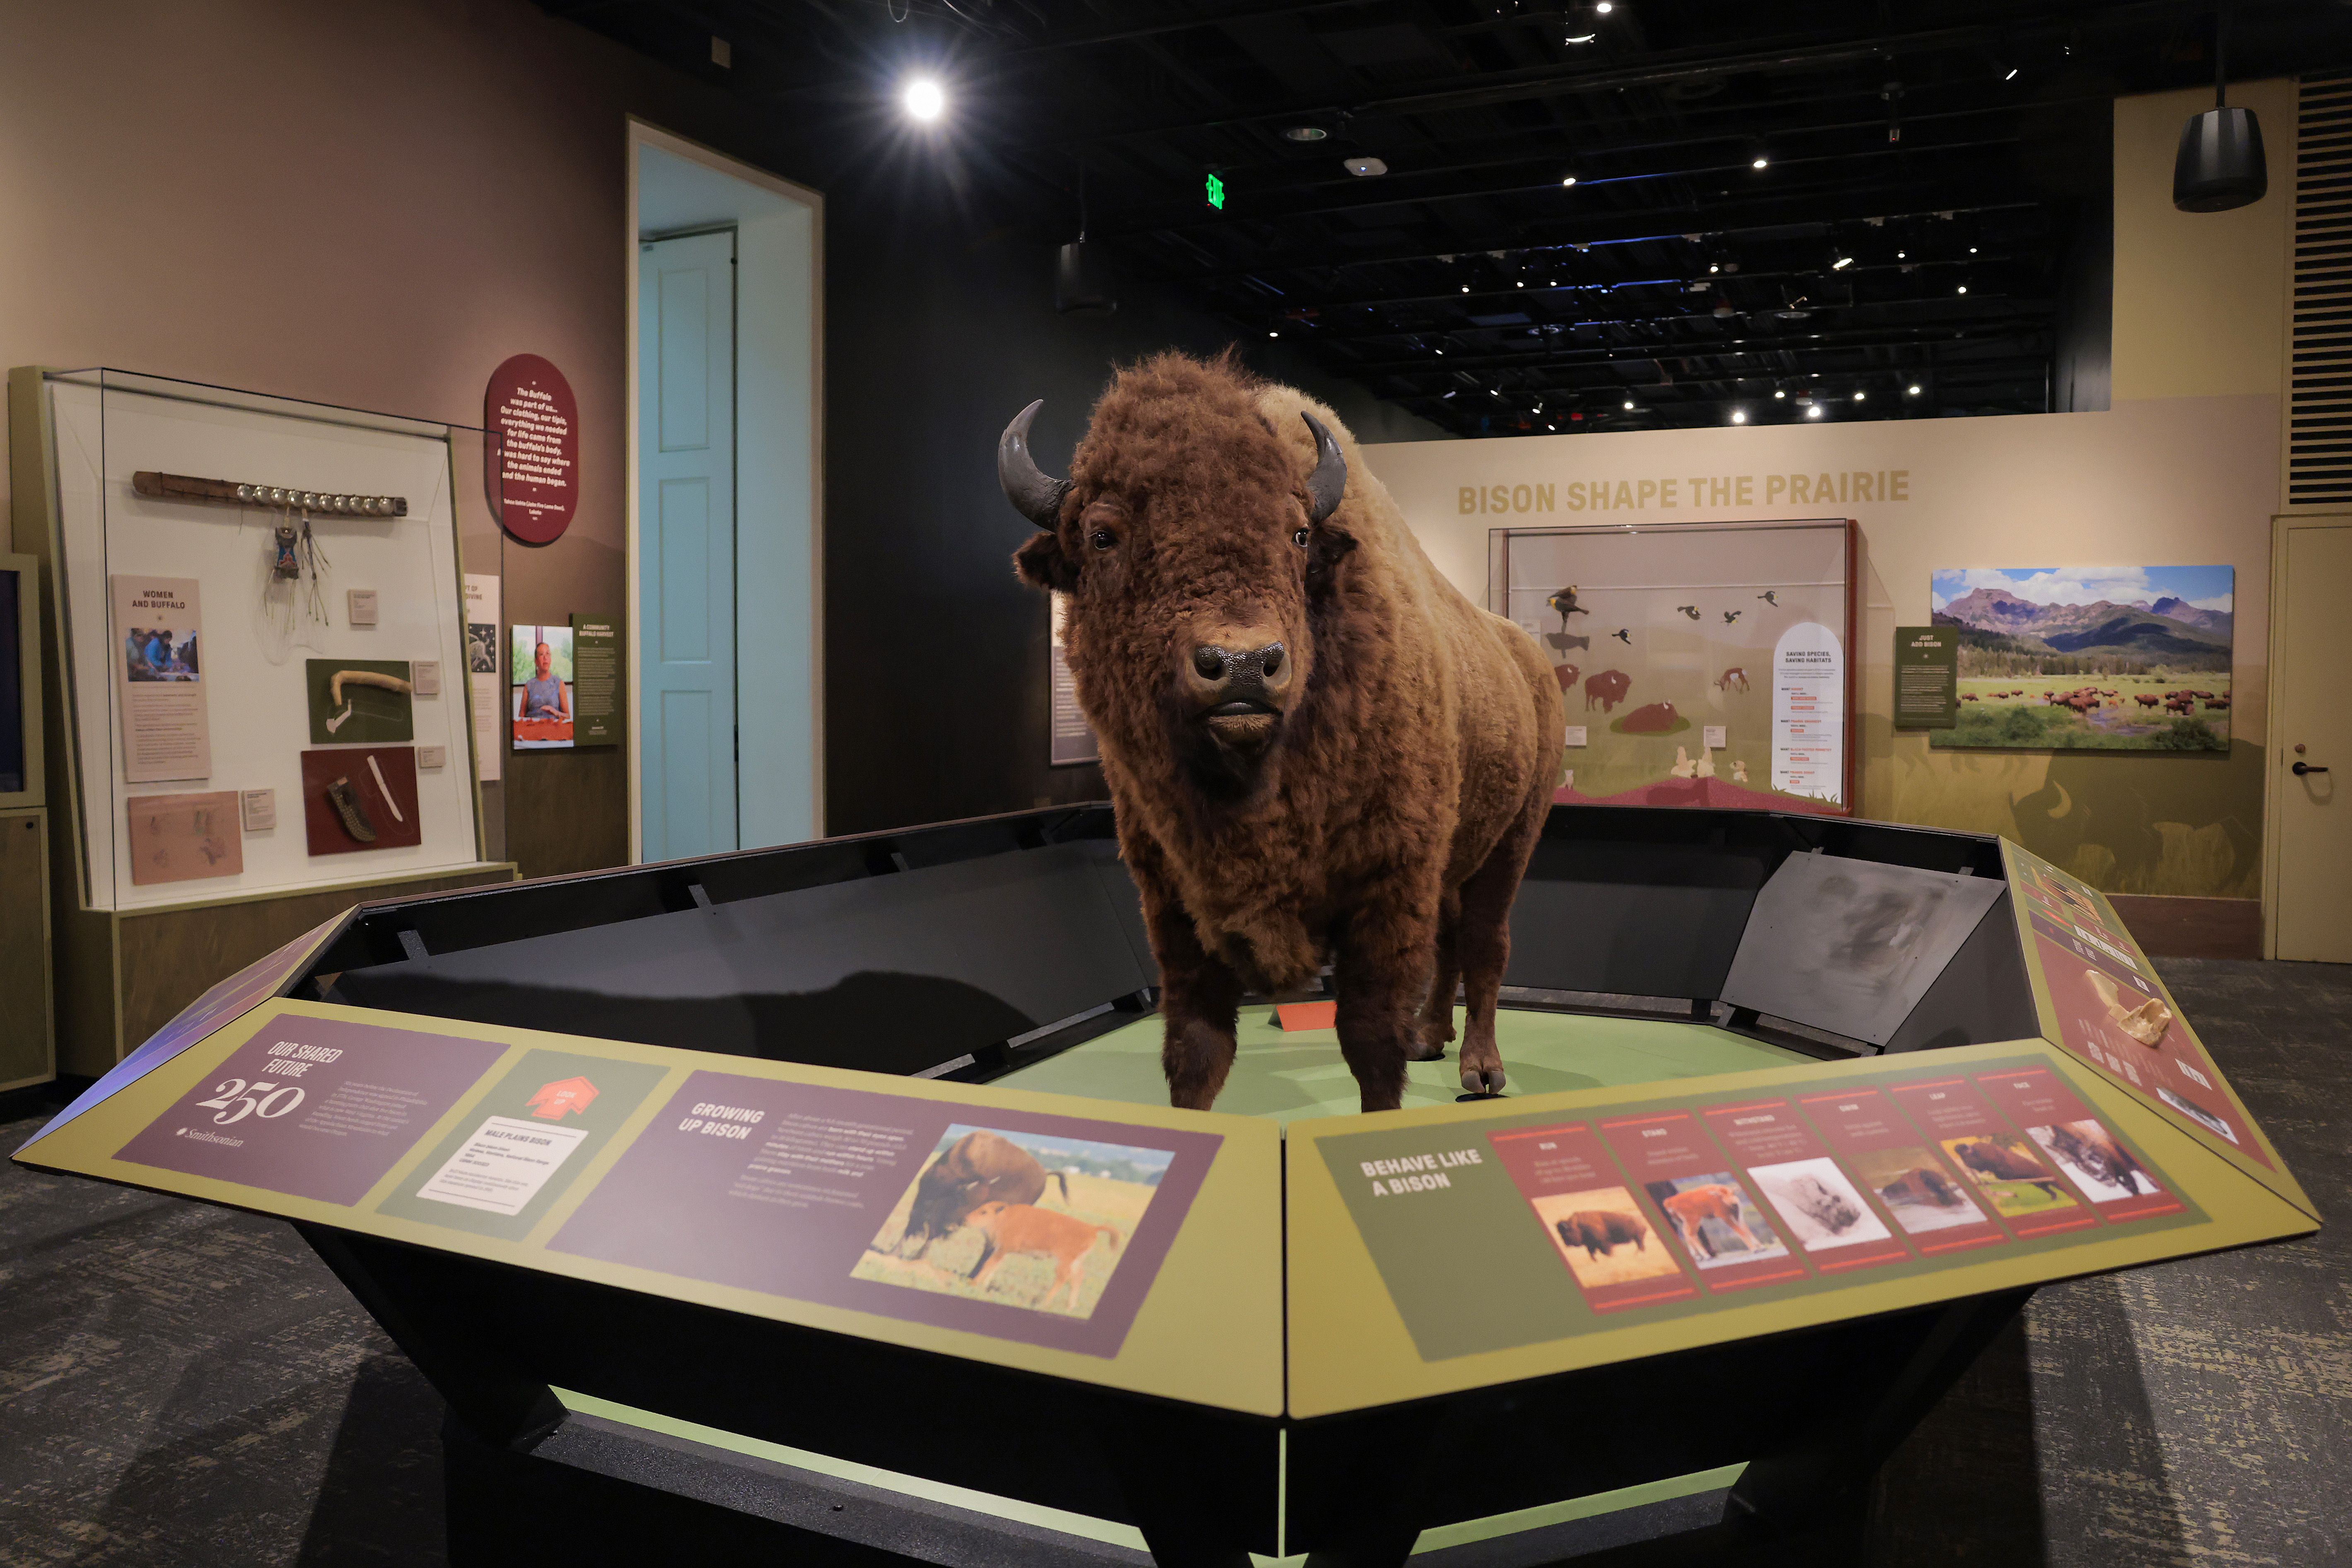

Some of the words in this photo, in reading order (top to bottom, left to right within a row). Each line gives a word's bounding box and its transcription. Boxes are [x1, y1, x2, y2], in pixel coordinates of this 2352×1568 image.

[517, 387, 529, 397] The
[529, 389, 552, 401] Buffalo
[500, 405, 512, 414] Our
[510, 398, 523, 406] was
[523, 401, 538, 409] part
[501, 418, 534, 431] everything
[545, 426, 567, 435] needed
[507, 428, 517, 437] for
[518, 430, 529, 439] life
[529, 434, 546, 442] came
[546, 435, 561, 444] from
[507, 439, 517, 448] the
[517, 451, 532, 461] hard
[533, 454, 540, 462] to
[540, 456, 551, 465] say
[552, 457, 570, 467] where
[507, 461, 518, 469] the
[519, 463, 543, 473] animals
[543, 467, 562, 475] ended
[514, 472, 525, 481] the
[526, 473, 546, 484] human
[1459, 483, 1555, 514] BISON
[1567, 479, 1677, 511] SHAPE
[1688, 476, 1753, 507] THE
[1766, 470, 1909, 505] PRAIRIE
[268, 1041, 299, 1057] OUR
[292, 1045, 343, 1063] SHARED
[262, 1059, 313, 1077] FUTURE
[196, 1078, 305, 1124] 250
[691, 1102, 765, 1124] GROWING
[678, 1118, 703, 1131] UP
[700, 1121, 752, 1140] BISON
[185, 1129, 244, 1147] Smithsonian
[504, 1133, 529, 1142] PLAINS
[529, 1137, 552, 1146] BISON
[1360, 1154, 1438, 1177] BEHAVE
[1437, 1148, 1483, 1168] LIKE
[1372, 1180, 1389, 1197] A
[1388, 1172, 1451, 1194] BISON
